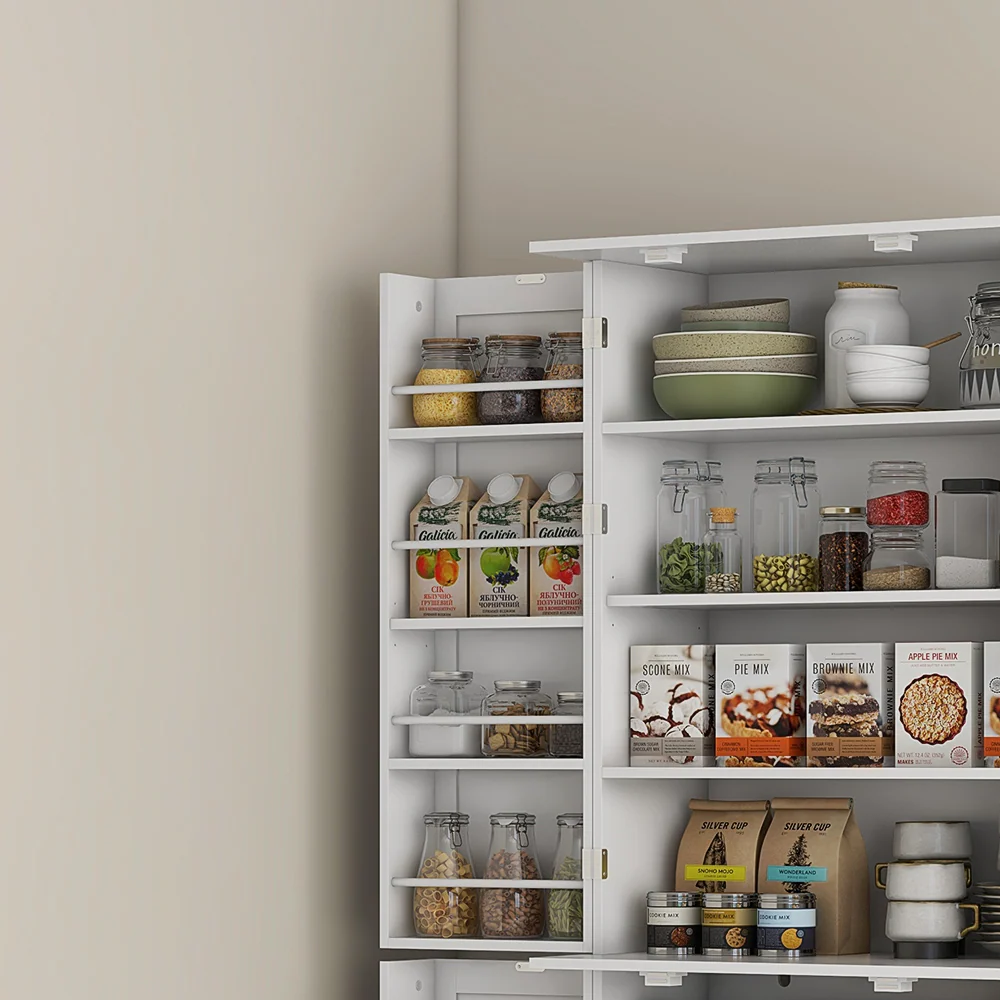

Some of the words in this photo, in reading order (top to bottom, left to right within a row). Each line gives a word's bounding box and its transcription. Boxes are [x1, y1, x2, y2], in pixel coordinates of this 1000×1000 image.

[418, 529, 458, 541] Galicia
[478, 529, 519, 540] Galicia
[538, 526, 581, 539] Galicia
[642, 664, 671, 676] SCONE
[674, 664, 691, 676] MIX
[734, 663, 749, 675] PIE
[753, 663, 769, 675] MIX
[812, 662, 854, 674] BROWNIE
[858, 662, 875, 674] MIX
[886, 665, 894, 683] MIX
[886, 687, 894, 731] BROWNIE
[701, 821, 729, 830] SILVER
[730, 821, 749, 830] CUP
[783, 822, 812, 831] SILVER
[812, 823, 831, 832] CUP
